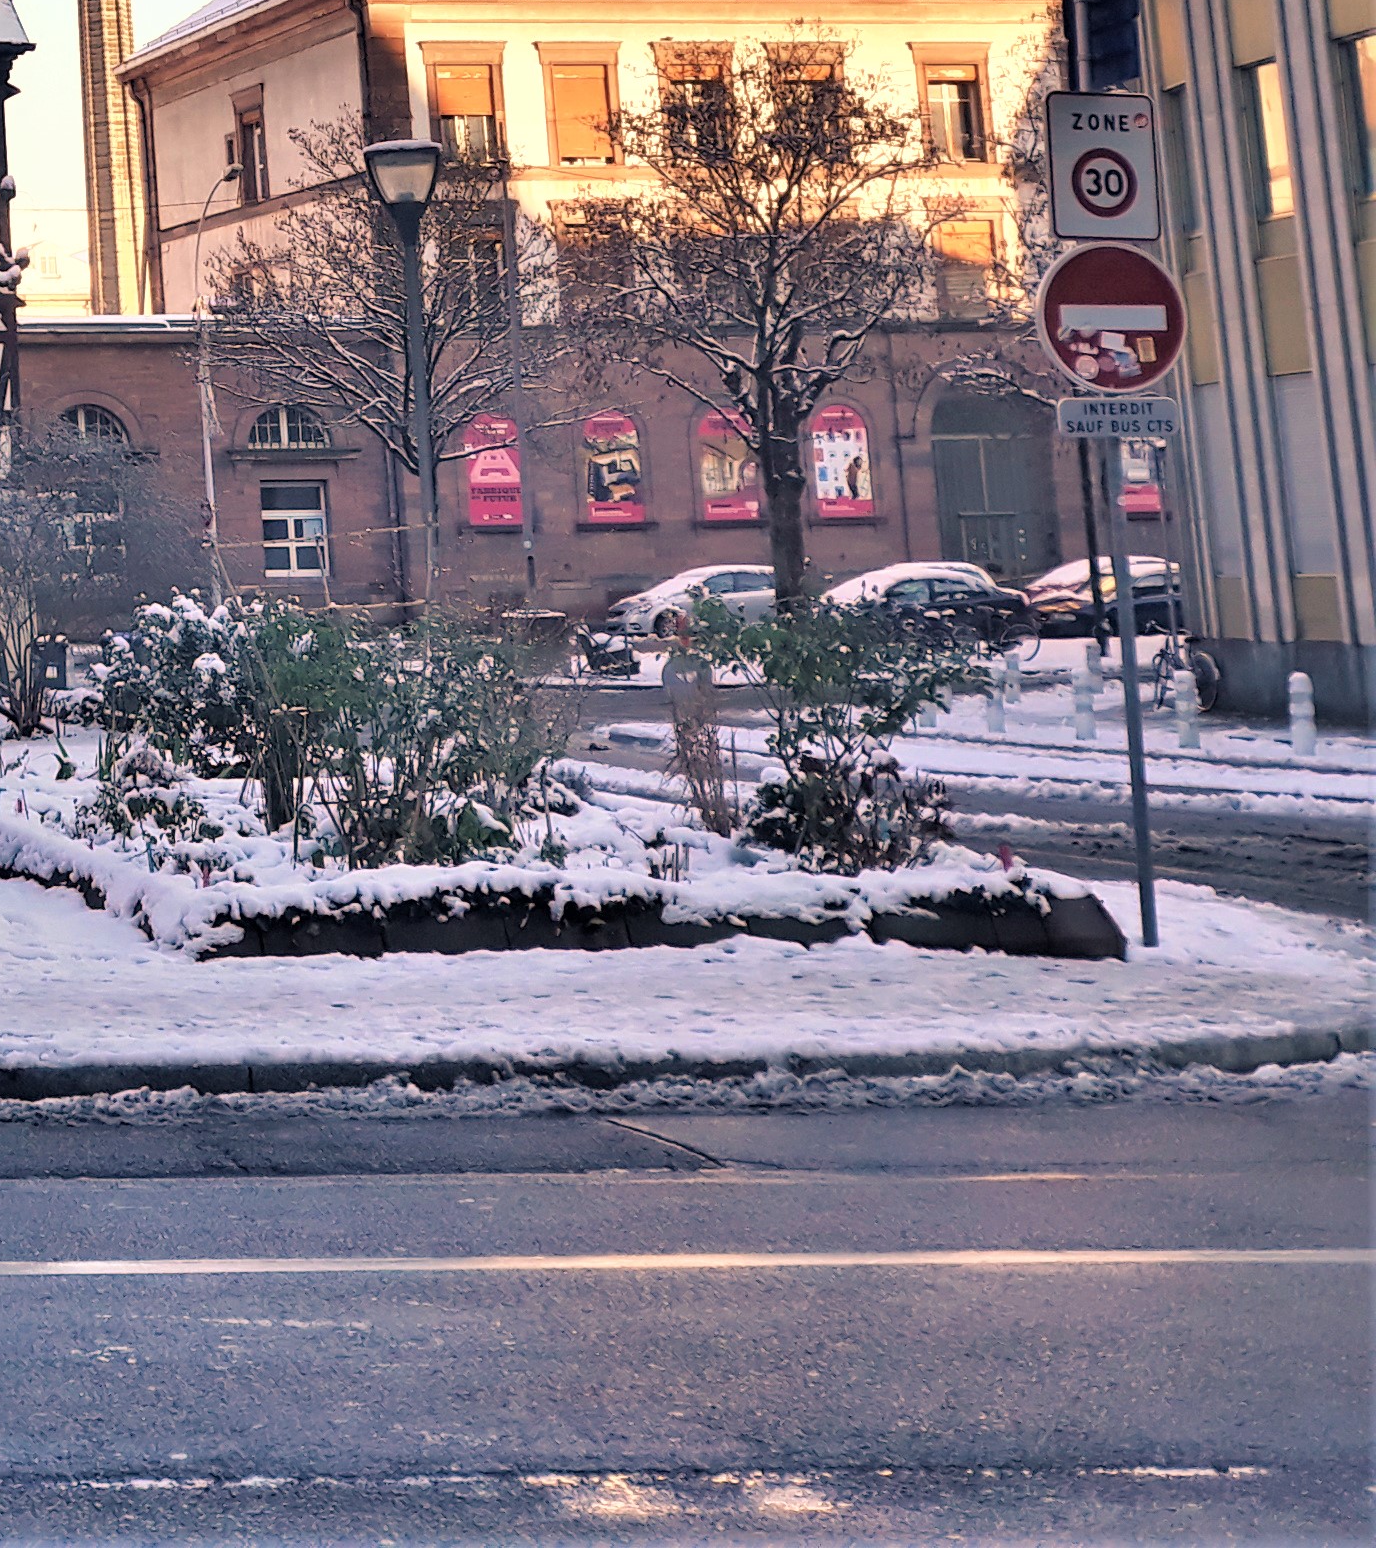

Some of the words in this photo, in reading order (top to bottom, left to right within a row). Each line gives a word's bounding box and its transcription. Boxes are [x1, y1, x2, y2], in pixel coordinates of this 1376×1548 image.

[1071, 113, 1130, 132] ZONE
[1085, 168, 1124, 197] 30
[1083, 402, 1154, 416] INTERDIT
[1066, 419, 1104, 433] SAUF
[1111, 419, 1142, 433] BUS
[1147, 419, 1174, 433] CTS
